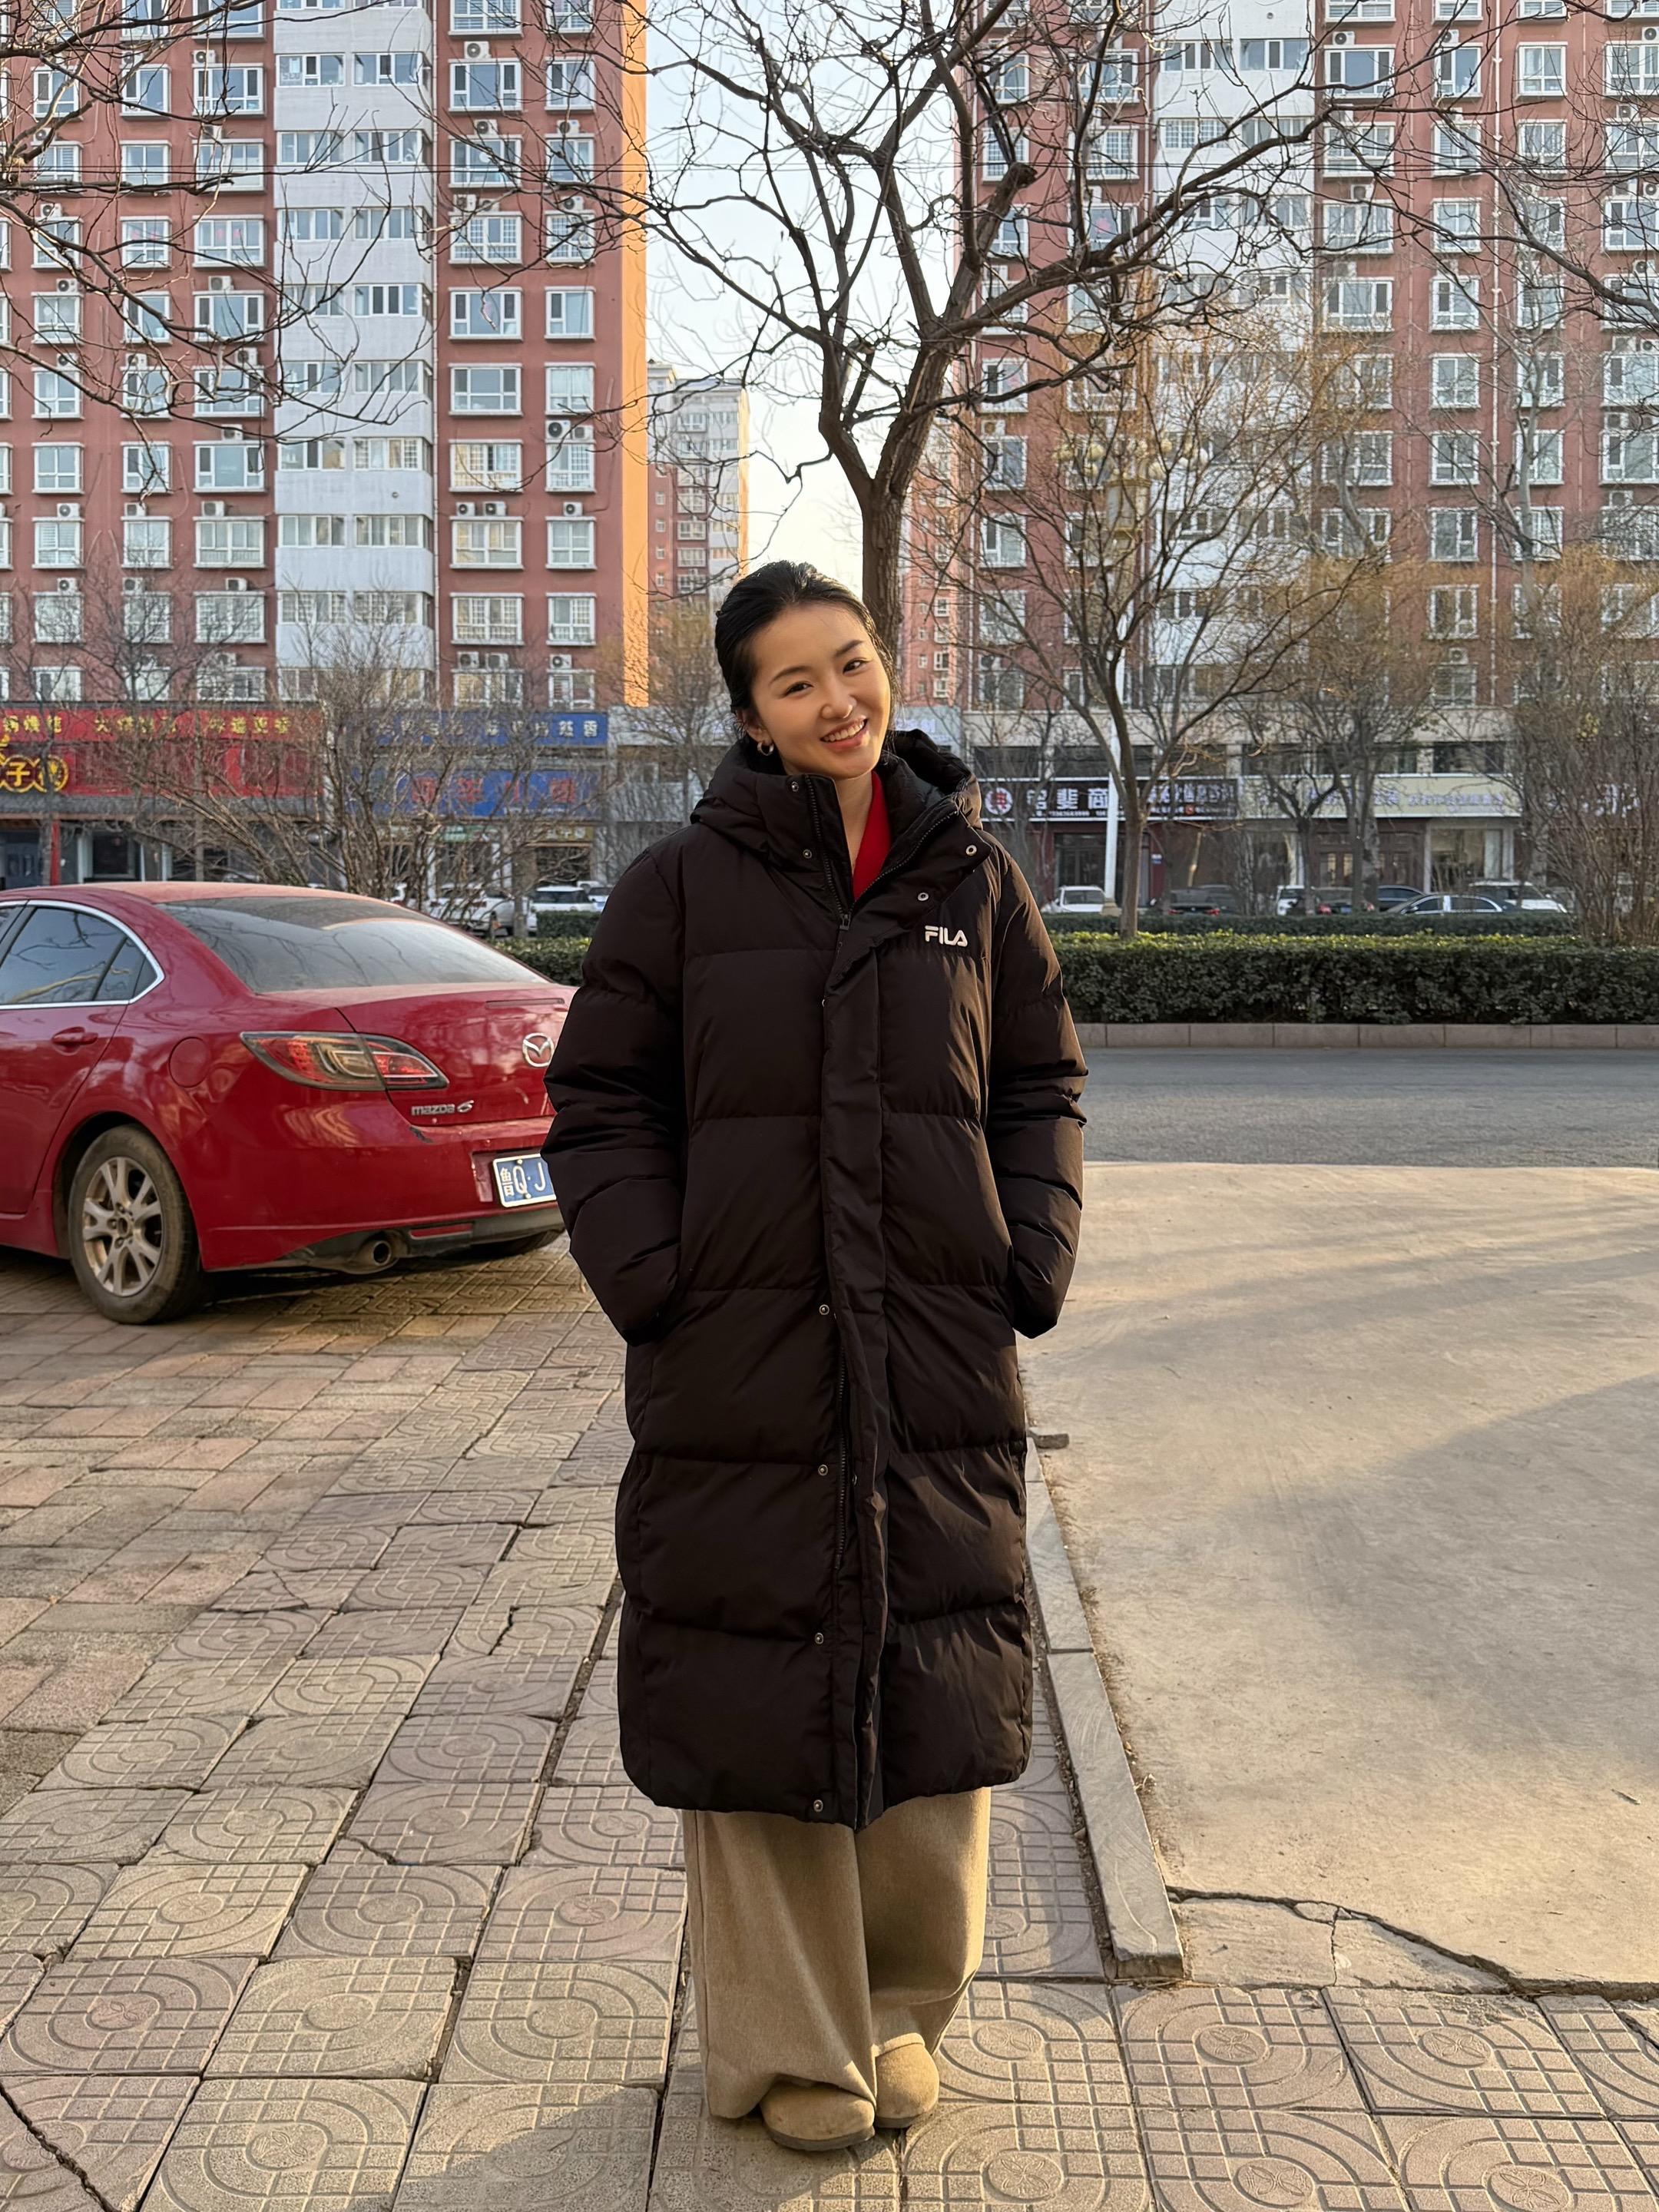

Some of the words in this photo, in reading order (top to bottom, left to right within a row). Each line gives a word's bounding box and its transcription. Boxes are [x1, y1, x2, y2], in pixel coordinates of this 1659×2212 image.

[925, 926, 968, 947] FILA
[412, 1104, 455, 1116] mazda
[457, 1100, 474, 1113] 6
